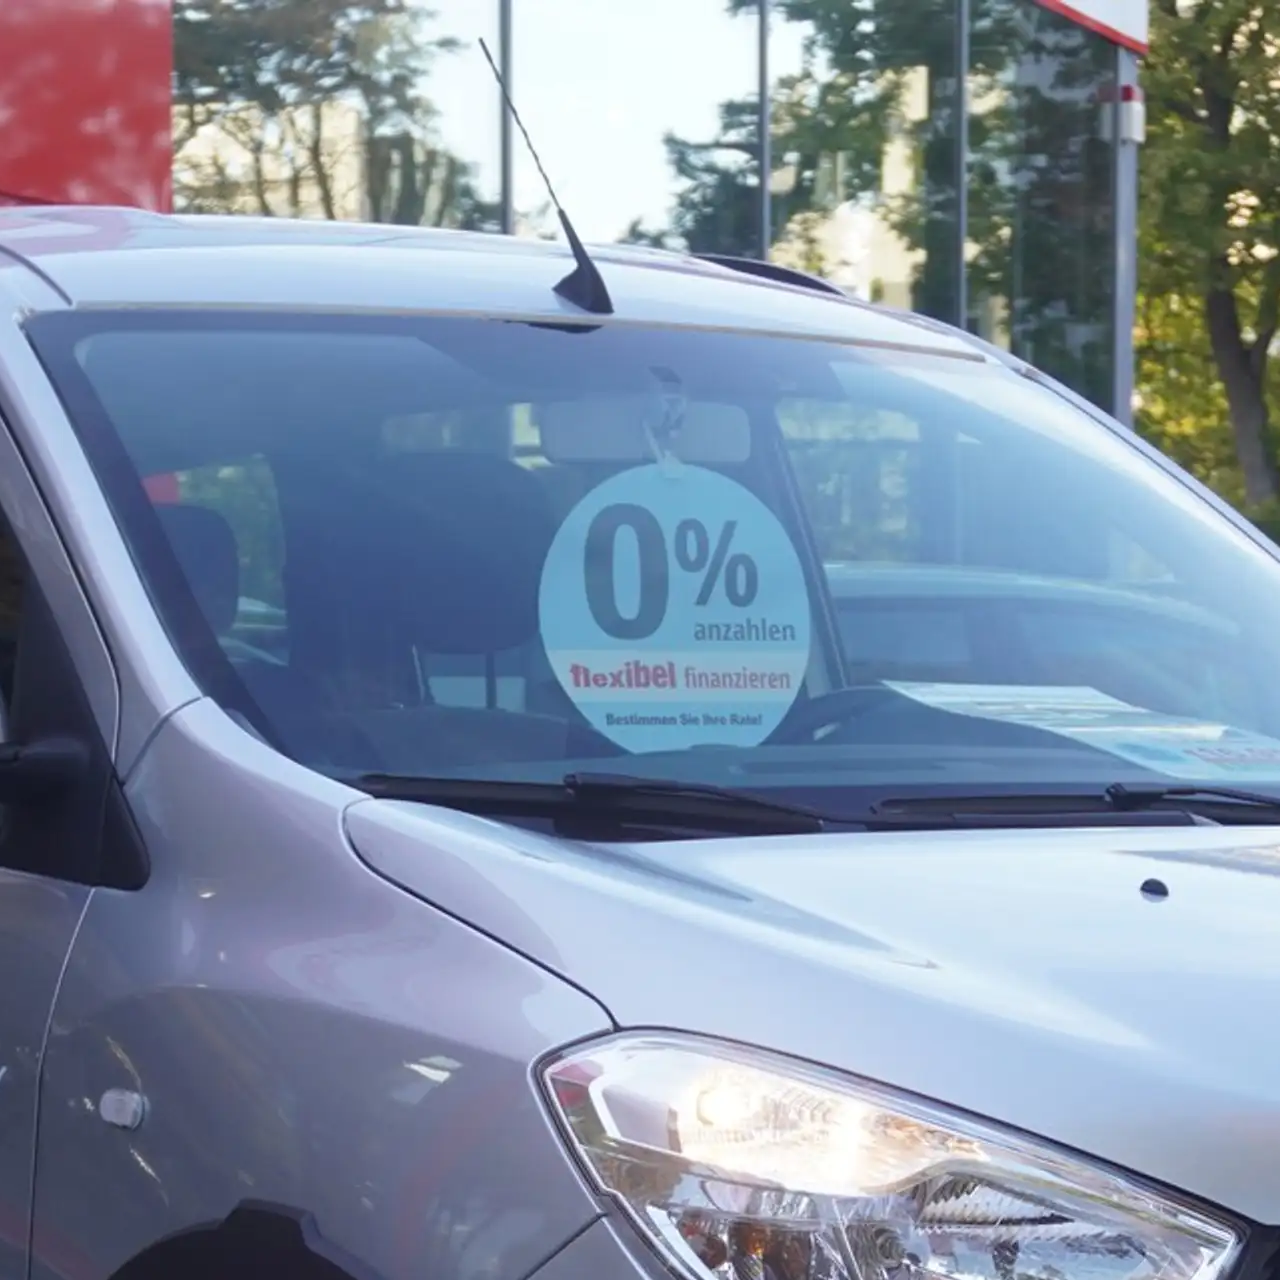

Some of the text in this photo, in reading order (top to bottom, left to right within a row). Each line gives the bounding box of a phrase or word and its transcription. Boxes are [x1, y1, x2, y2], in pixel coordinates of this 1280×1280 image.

[582, 502, 759, 641] 0%
[693, 617, 796, 642] anzahlen
[569, 660, 791, 690] flexibel finanzieren
[605, 711, 678, 727] Bestimmen
[679, 711, 701, 727] Sie
[702, 711, 727, 727] Ihre
